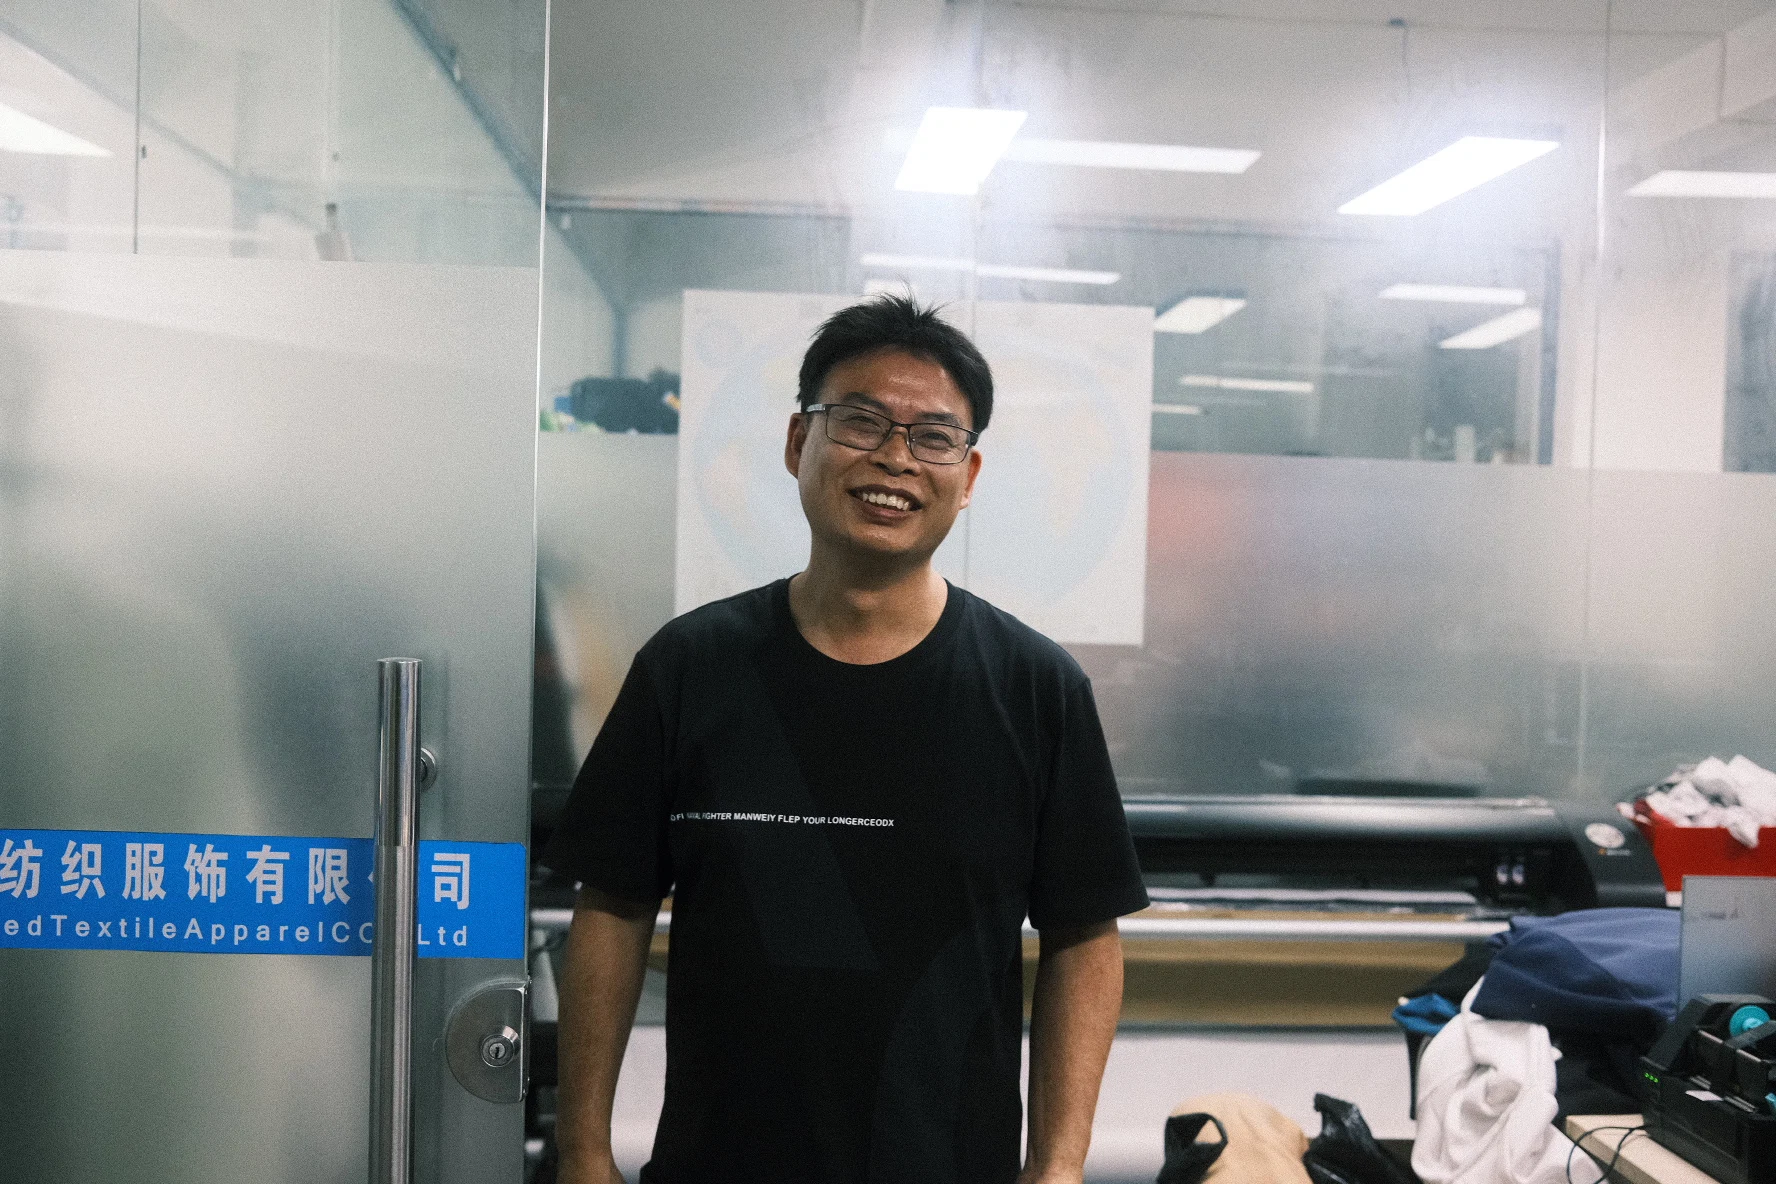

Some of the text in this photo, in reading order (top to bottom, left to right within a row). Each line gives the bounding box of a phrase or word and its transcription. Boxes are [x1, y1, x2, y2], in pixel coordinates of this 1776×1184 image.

[733, 813, 776, 822] MANWEIY
[777, 814, 801, 823] FLEP
[802, 816, 826, 825] YOUR
[0, 838, 471, 910] 纺织服饰有限司
